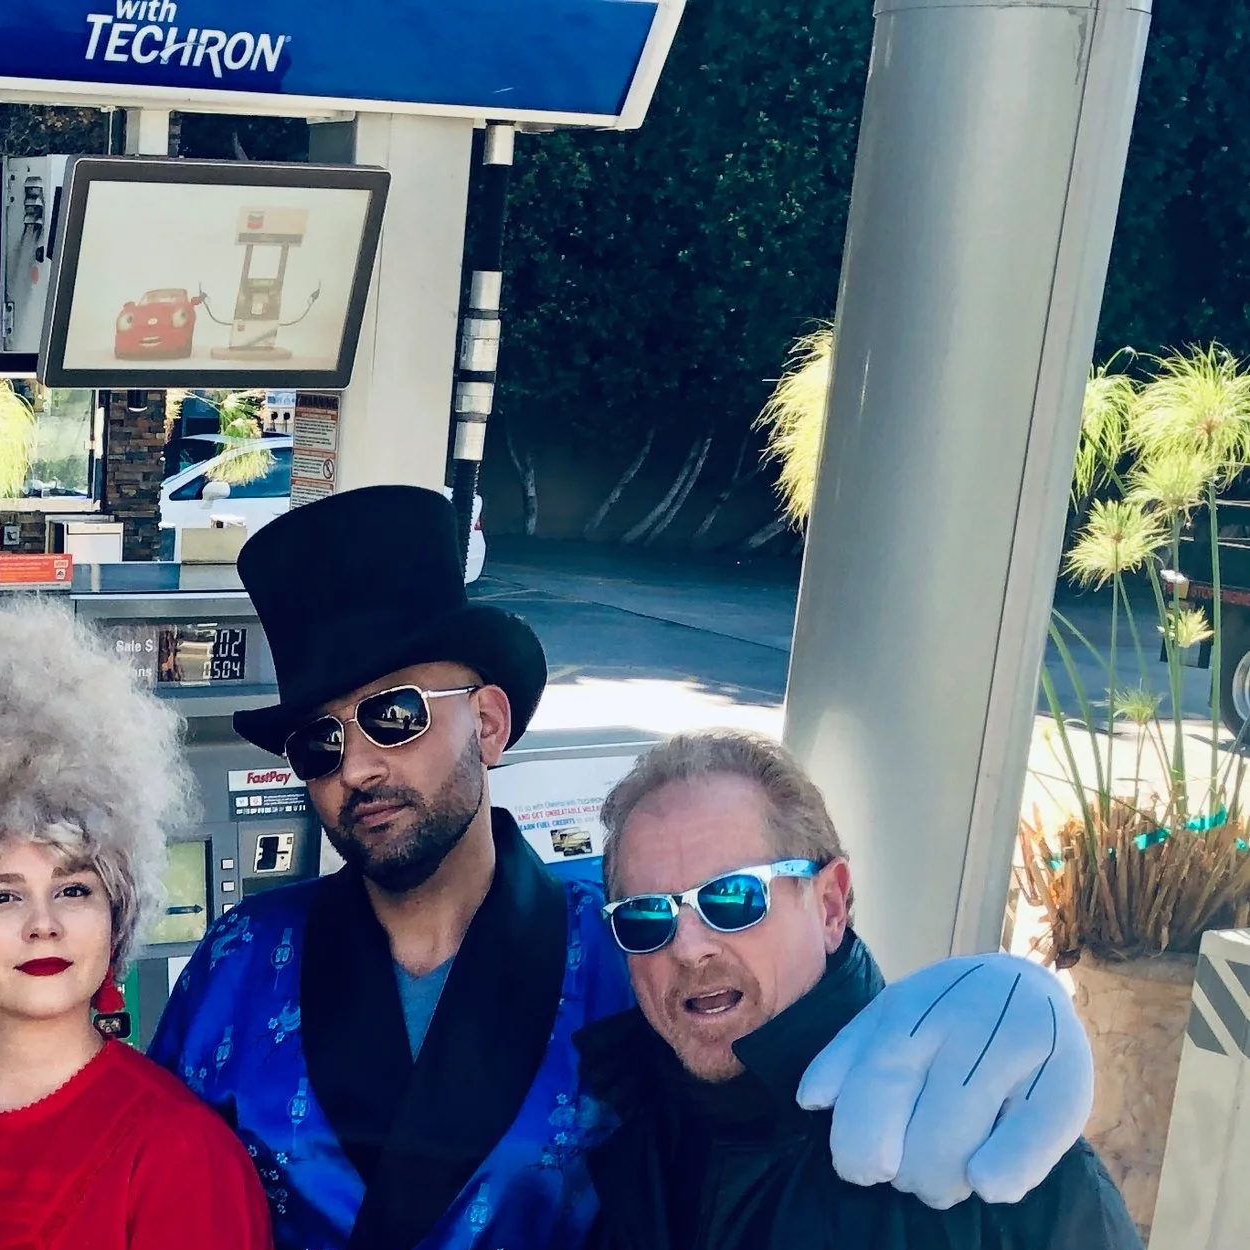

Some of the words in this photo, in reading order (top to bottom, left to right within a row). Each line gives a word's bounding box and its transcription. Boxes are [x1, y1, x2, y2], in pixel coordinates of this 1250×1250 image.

[116, 0, 177, 22] with
[85, 13, 286, 78] TECHRON
[115, 640, 142, 653] Sale
[145, 639, 154, 653] $
[247, 771, 291, 785] FastPay
